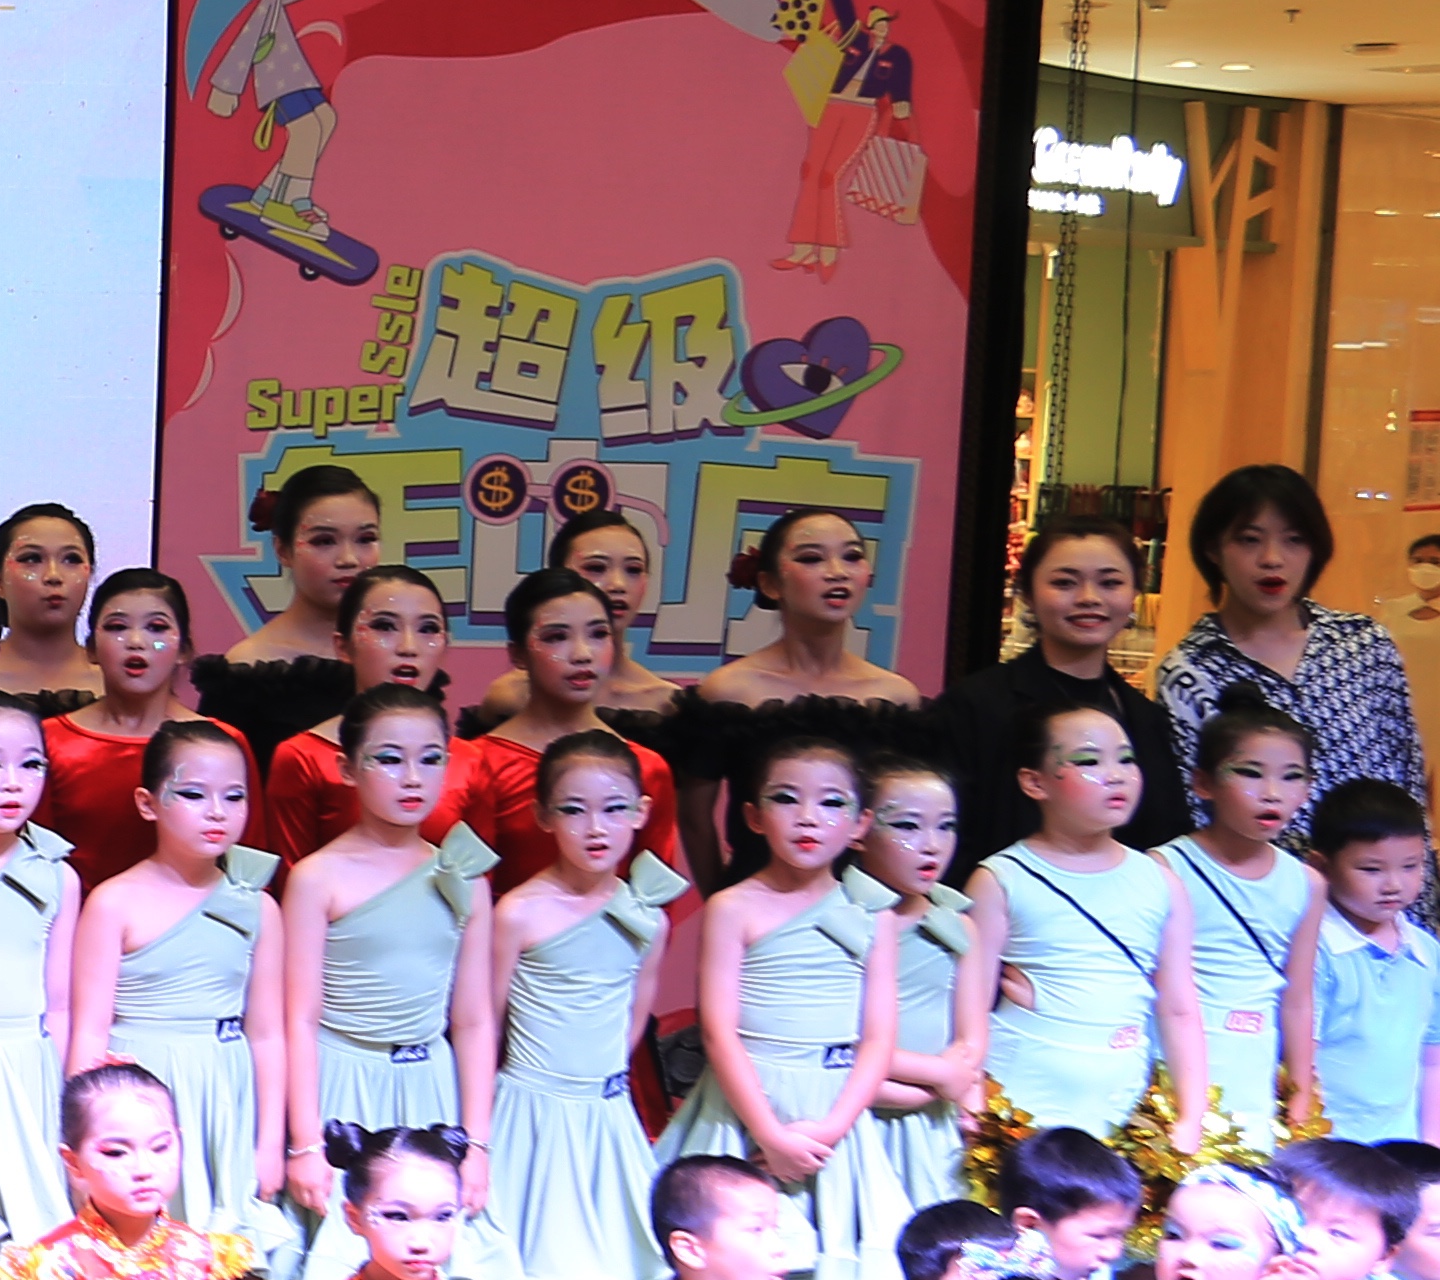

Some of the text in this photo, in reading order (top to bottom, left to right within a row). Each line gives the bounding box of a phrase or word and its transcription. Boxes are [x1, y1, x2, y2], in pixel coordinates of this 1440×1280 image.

[361, 264, 423, 377] Ssle
[408, 260, 748, 447] 超级
[246, 378, 404, 438] Super
